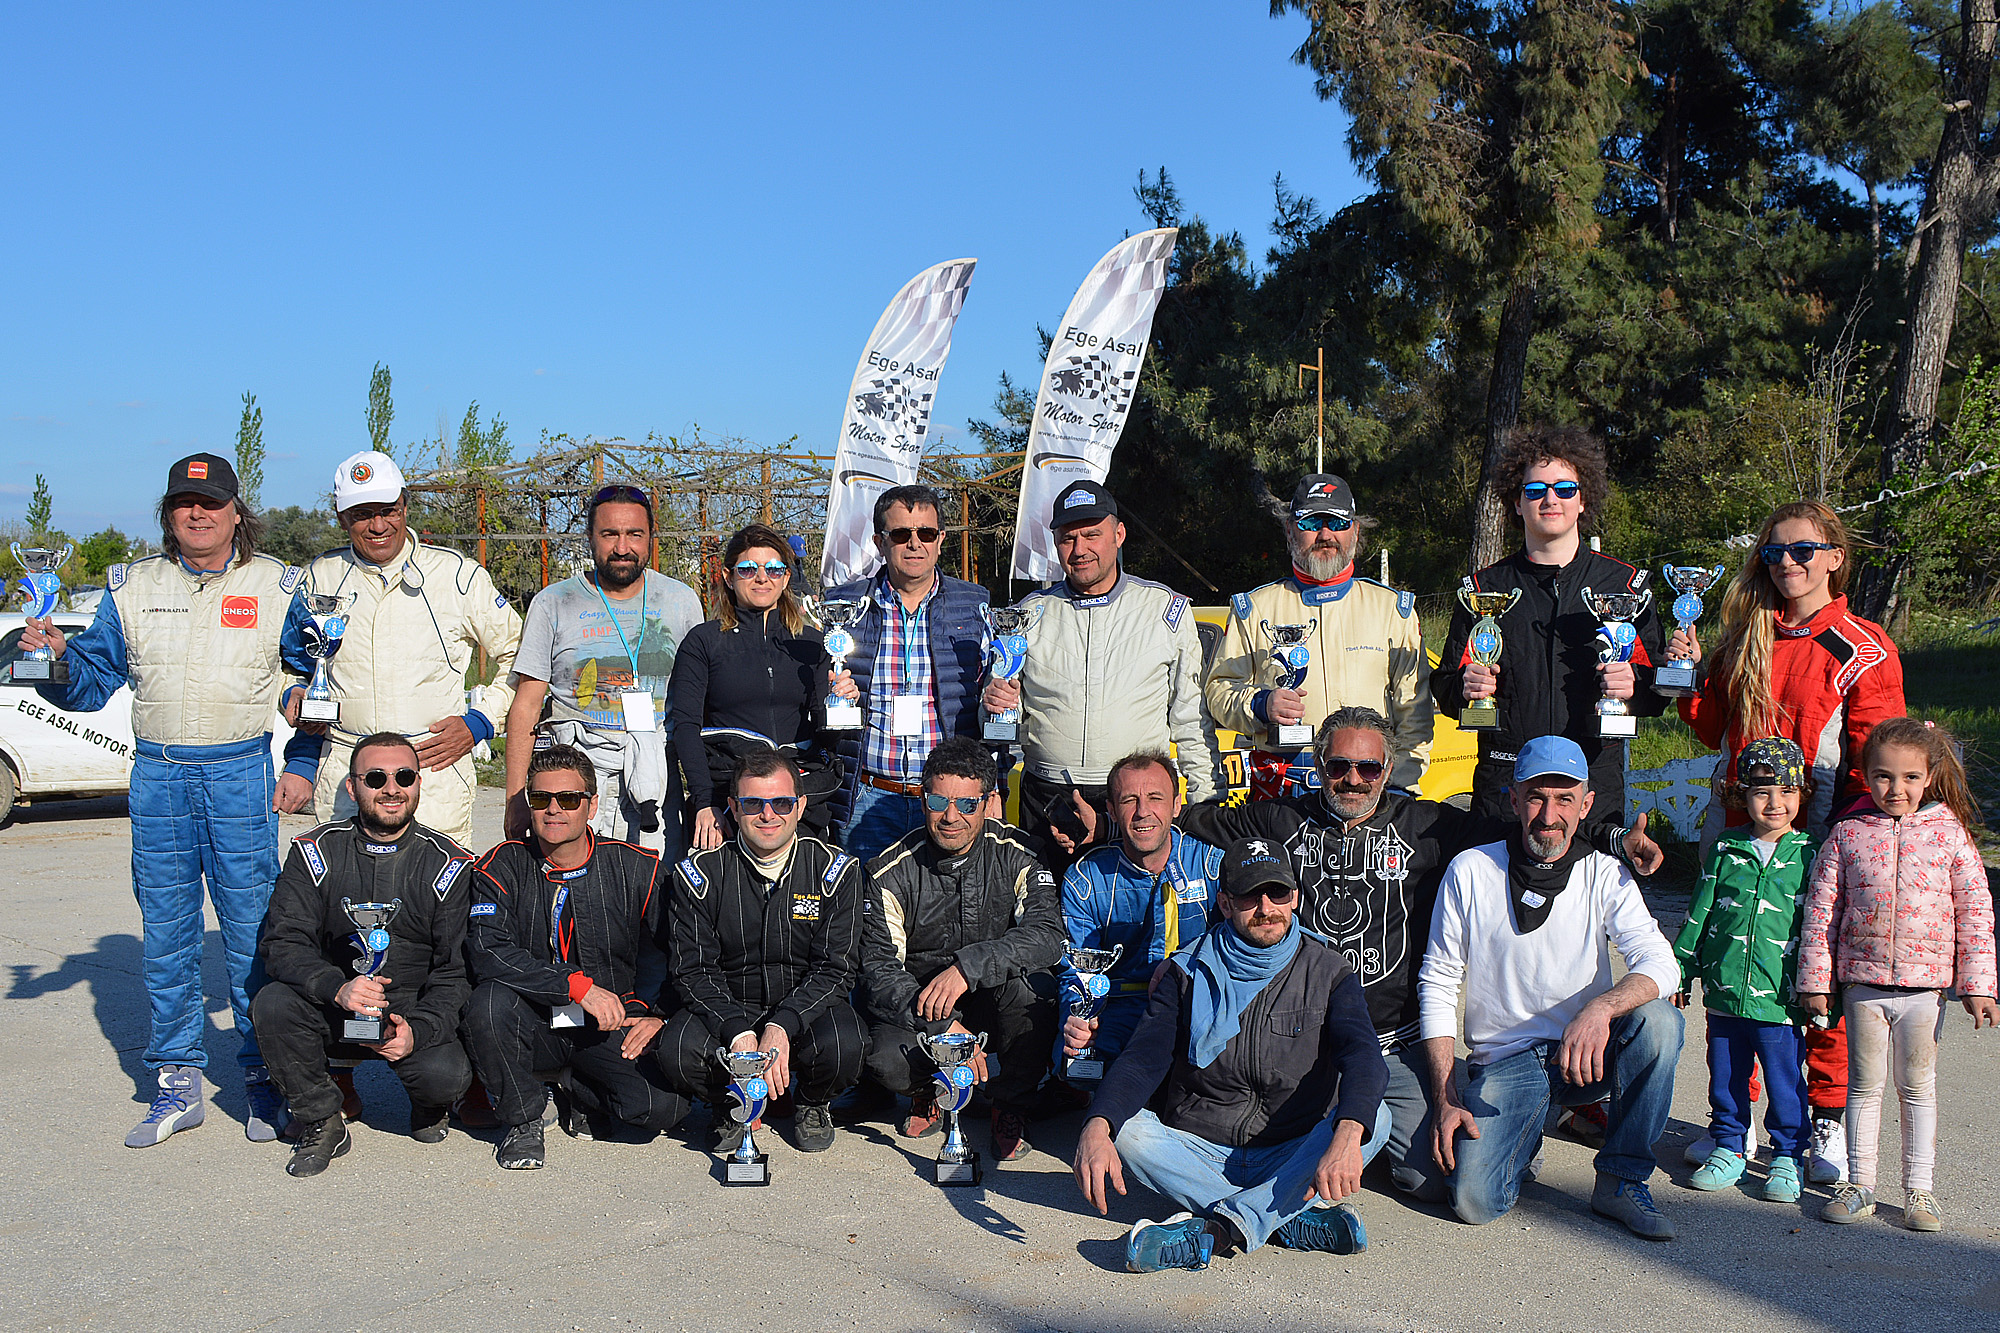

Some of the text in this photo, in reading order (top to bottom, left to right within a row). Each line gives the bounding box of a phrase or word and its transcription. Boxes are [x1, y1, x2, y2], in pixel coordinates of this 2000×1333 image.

[1064, 326, 1143, 358] Ege Asal
[867, 350, 940, 381] Ege Asal
[1043, 401, 1120, 434] Motor Spor
[849, 422, 921, 454] Motor Spor
[1050, 465, 1061, 473] ege
[223, 608, 256, 617] ENEOS
[579, 610, 607, 620] Crazy
[610, 607, 638, 616] Waves
[1168, 598, 1185, 622] sparco
[582, 626, 612, 639] CAMP
[1839, 662, 1861, 688] sparco
[17, 699, 46, 721] EGE
[46, 713, 80, 736] ASAL
[82, 728, 129, 757] MOTOR
[1222, 754, 1242, 785] 17
[304, 844, 323, 876] sparco
[366, 844, 397, 854] sparco
[1241, 854, 1281, 868] PEUGEOT
[437, 861, 462, 891] sparco
[682, 859, 702, 886] sparco
[827, 854, 848, 883] sparco
